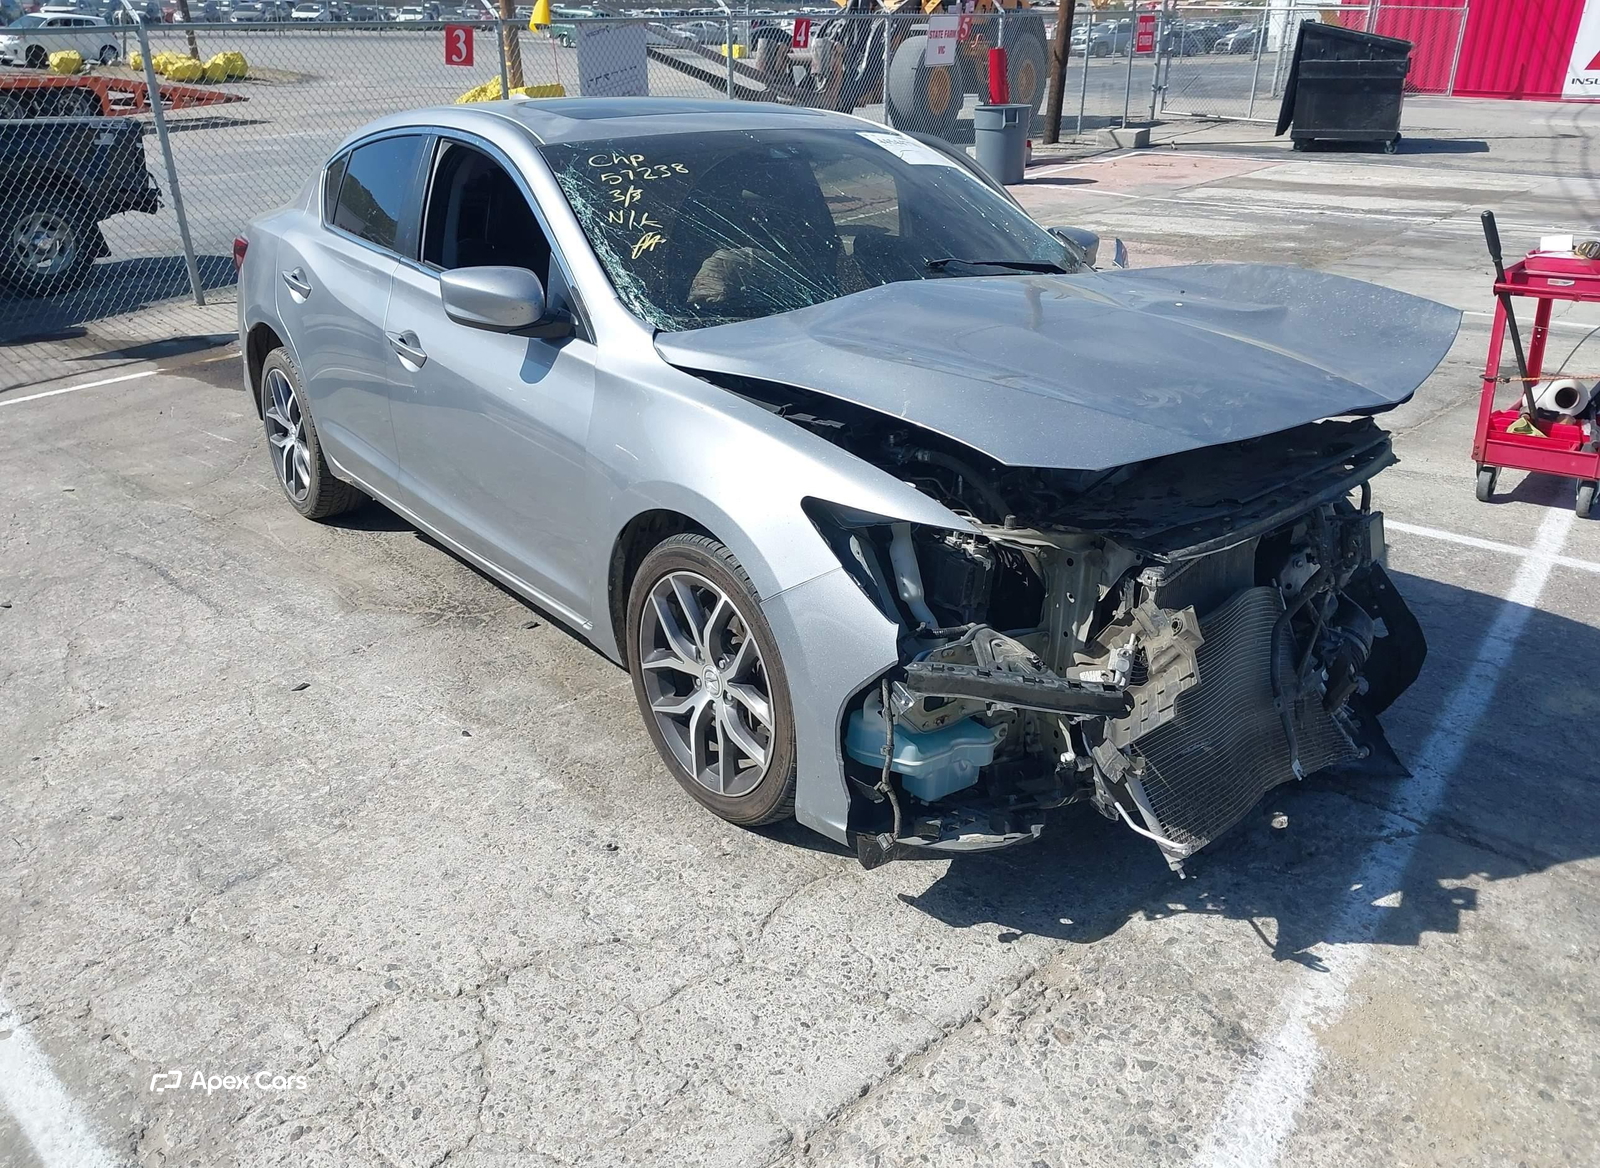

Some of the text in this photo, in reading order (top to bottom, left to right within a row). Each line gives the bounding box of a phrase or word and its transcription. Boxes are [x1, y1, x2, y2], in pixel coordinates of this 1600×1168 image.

[796, 21, 807, 46] 4
[929, 30, 944, 39] STATE
[960, 17, 970, 38] 5
[452, 29, 467, 63] 3
